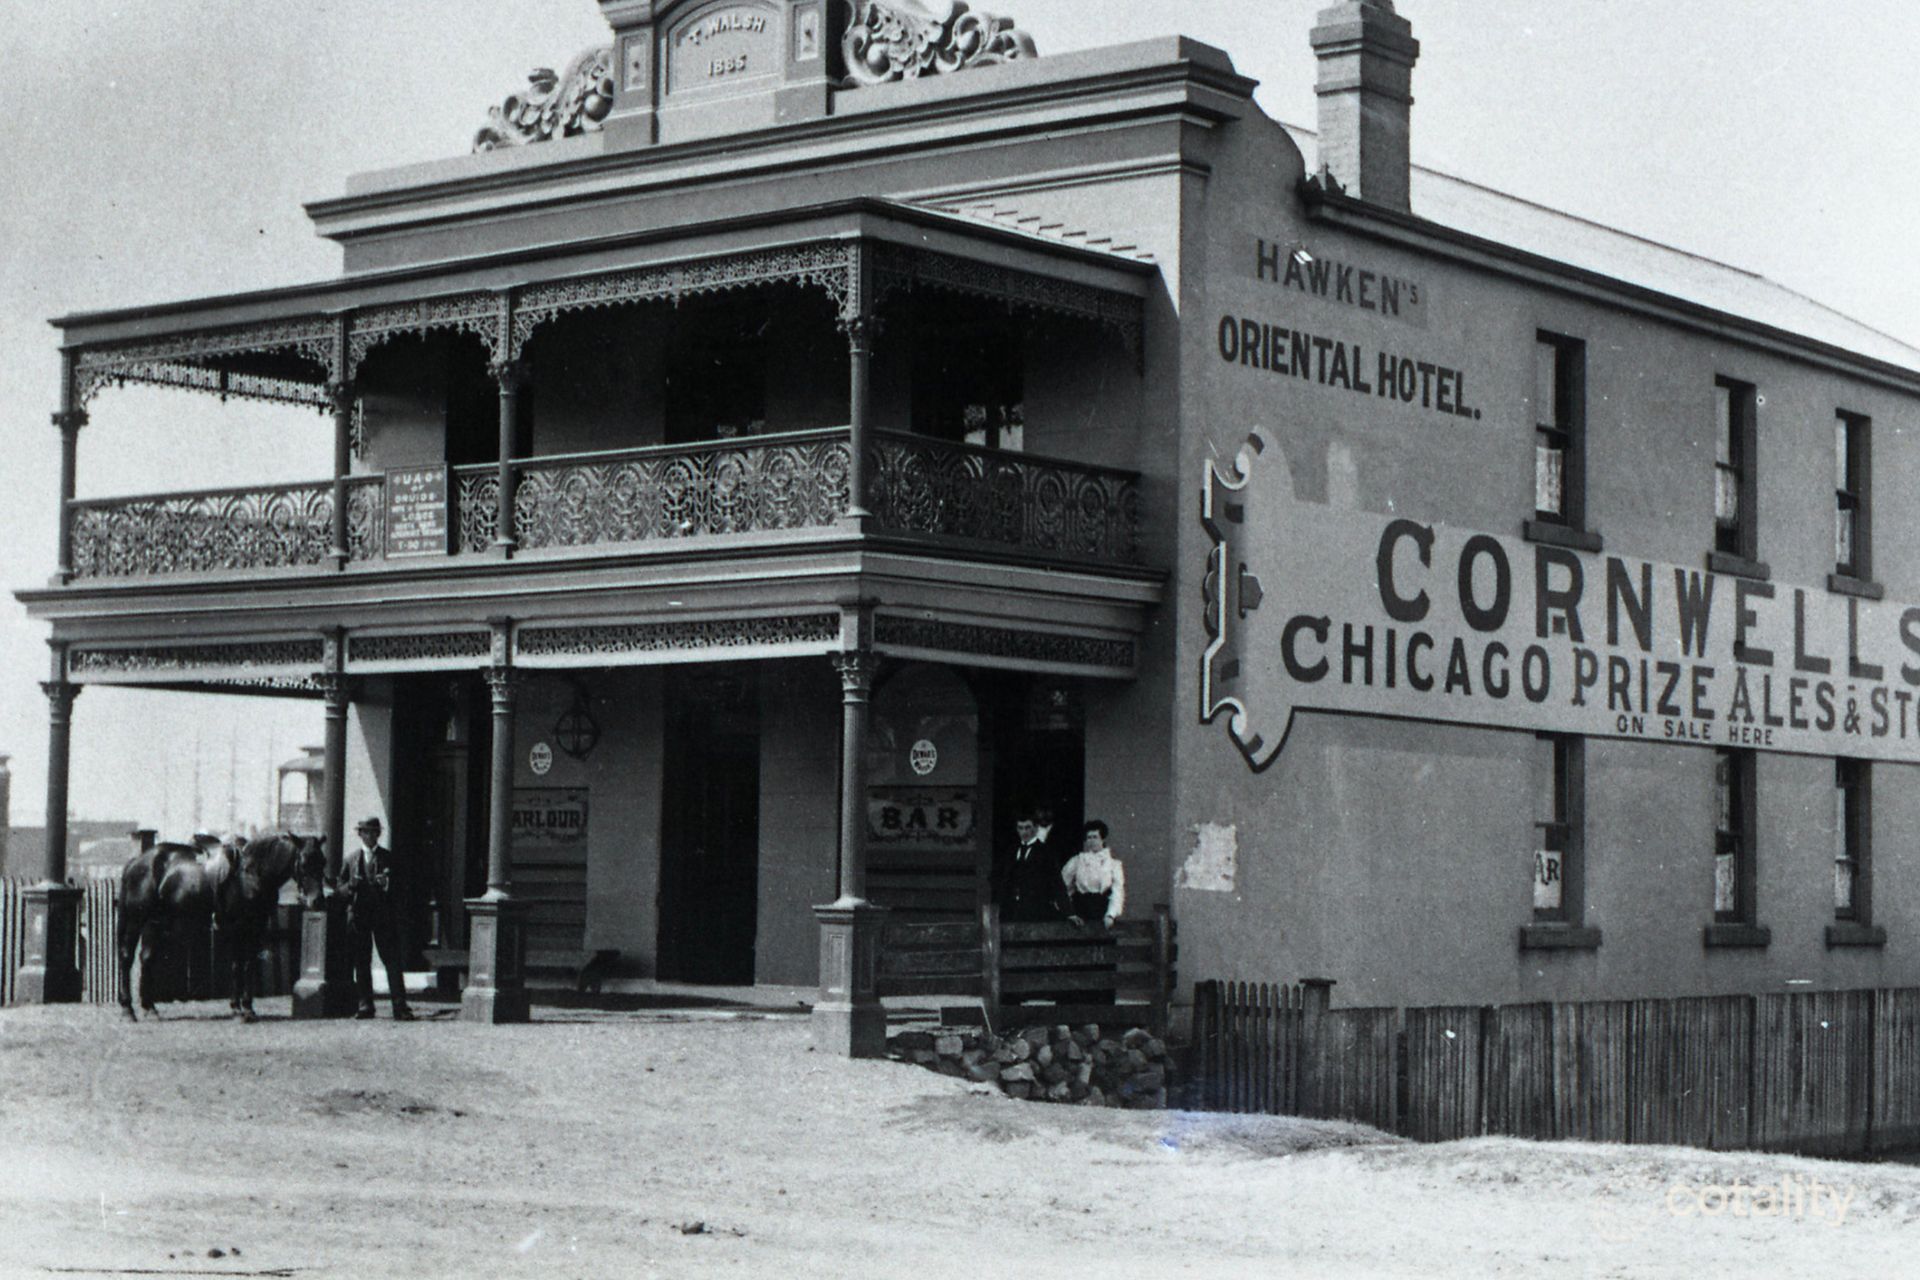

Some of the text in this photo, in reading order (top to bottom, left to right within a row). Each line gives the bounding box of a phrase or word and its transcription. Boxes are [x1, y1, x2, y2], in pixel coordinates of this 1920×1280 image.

[709, 13, 767, 36] WALSH
[1256, 239, 1419, 316] HAWKEN'S
[1218, 314, 1481, 420] ORIENTAL HOTEL.
[1376, 518, 1920, 686] CORNWELLS
[1280, 614, 1920, 740] CHICAGO PRIZE ALES & ST
[1617, 714, 1773, 746] ON SALE HERE
[512, 810, 581, 828] ARLOUR
[882, 806, 959, 830] BAR
